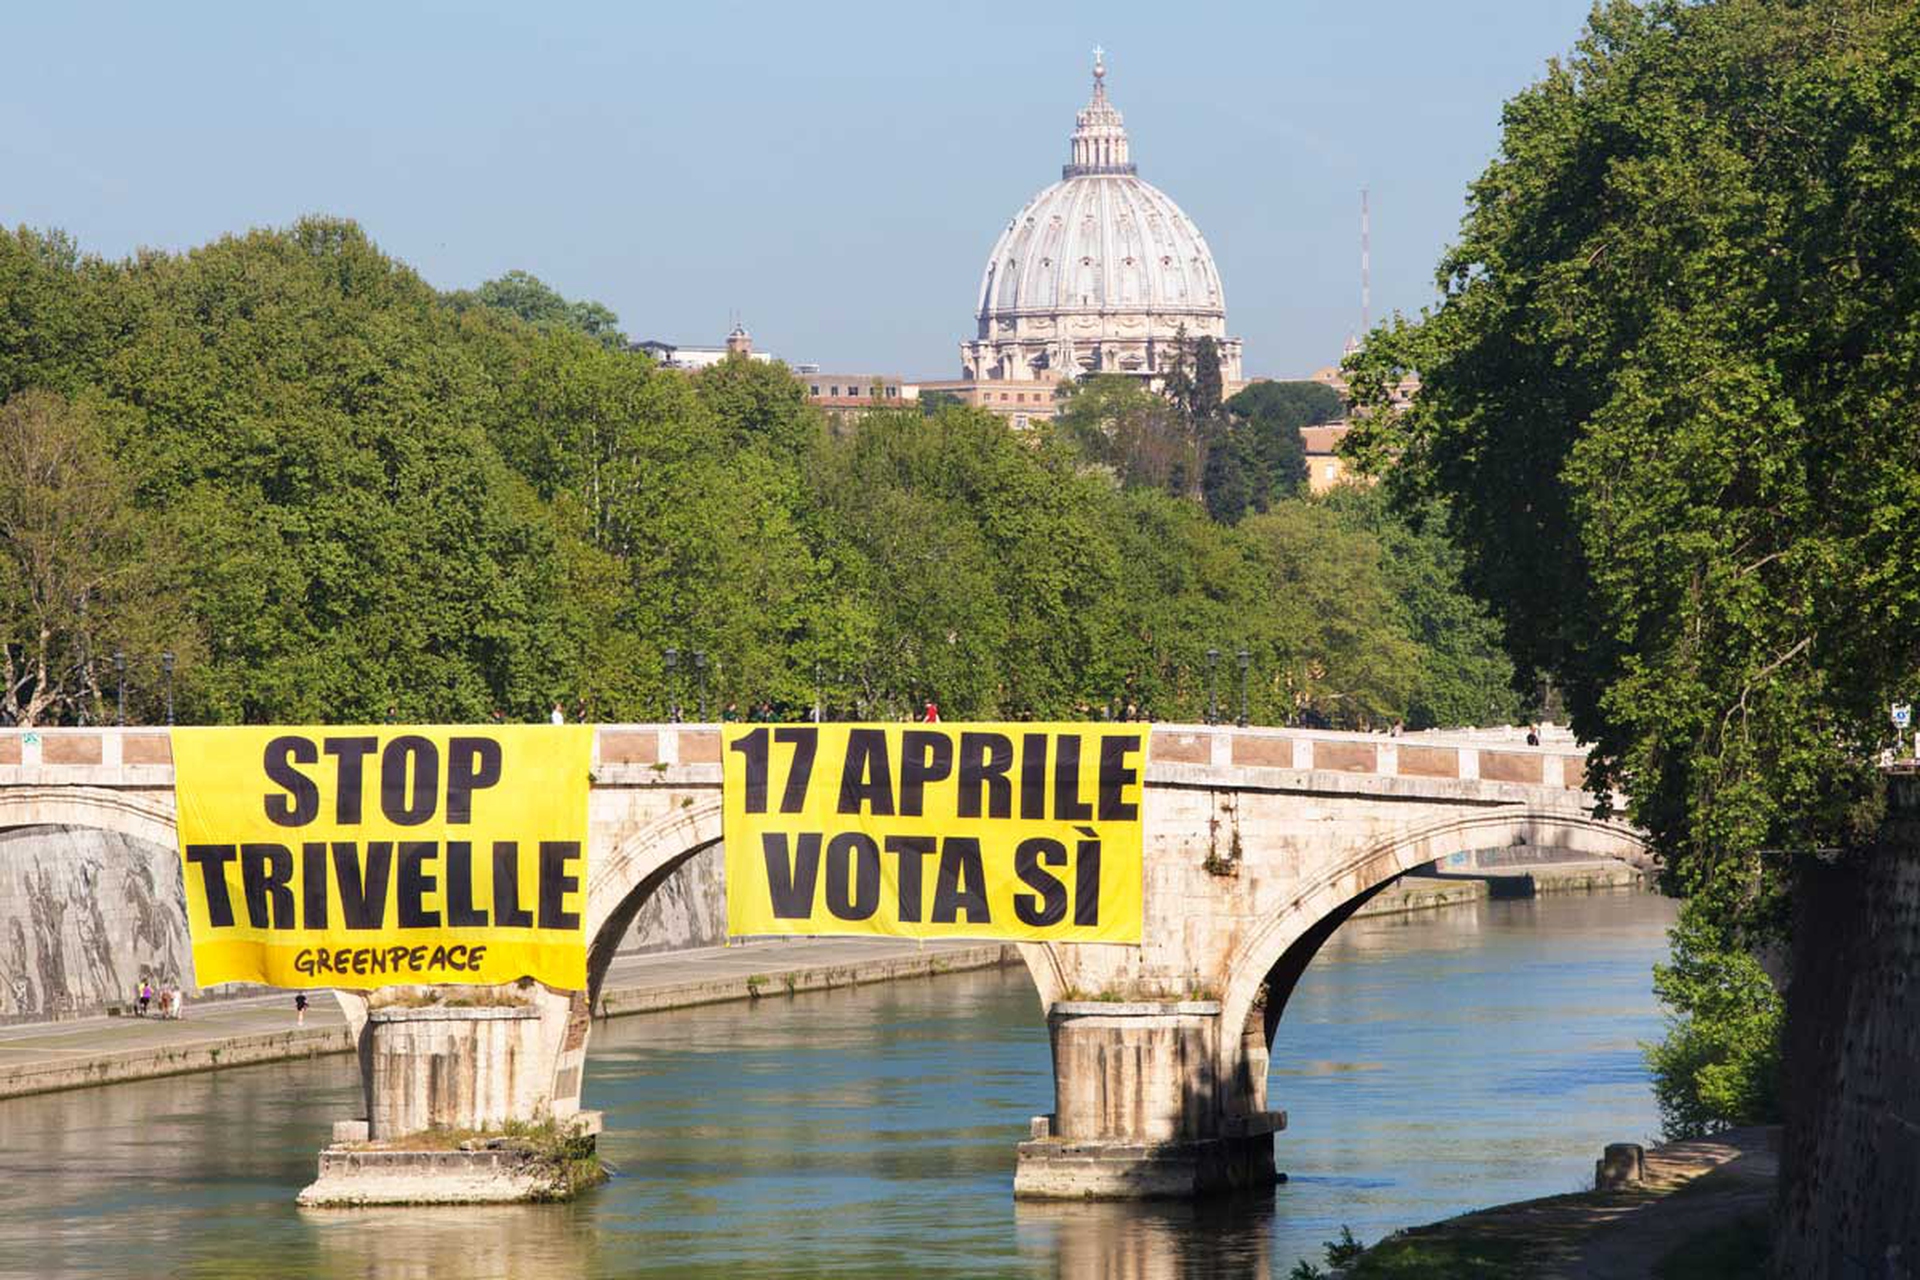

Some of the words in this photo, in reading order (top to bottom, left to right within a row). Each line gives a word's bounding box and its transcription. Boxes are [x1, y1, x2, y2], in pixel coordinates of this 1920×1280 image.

[264, 735, 502, 827] STOP
[730, 727, 818, 814] 17
[837, 728, 1141, 821] APRILE
[186, 841, 581, 930] TRIVELLE
[762, 832, 991, 924] VOTA
[1013, 825, 1101, 927] SÌ
[294, 945, 487, 977] GREENPEACE
